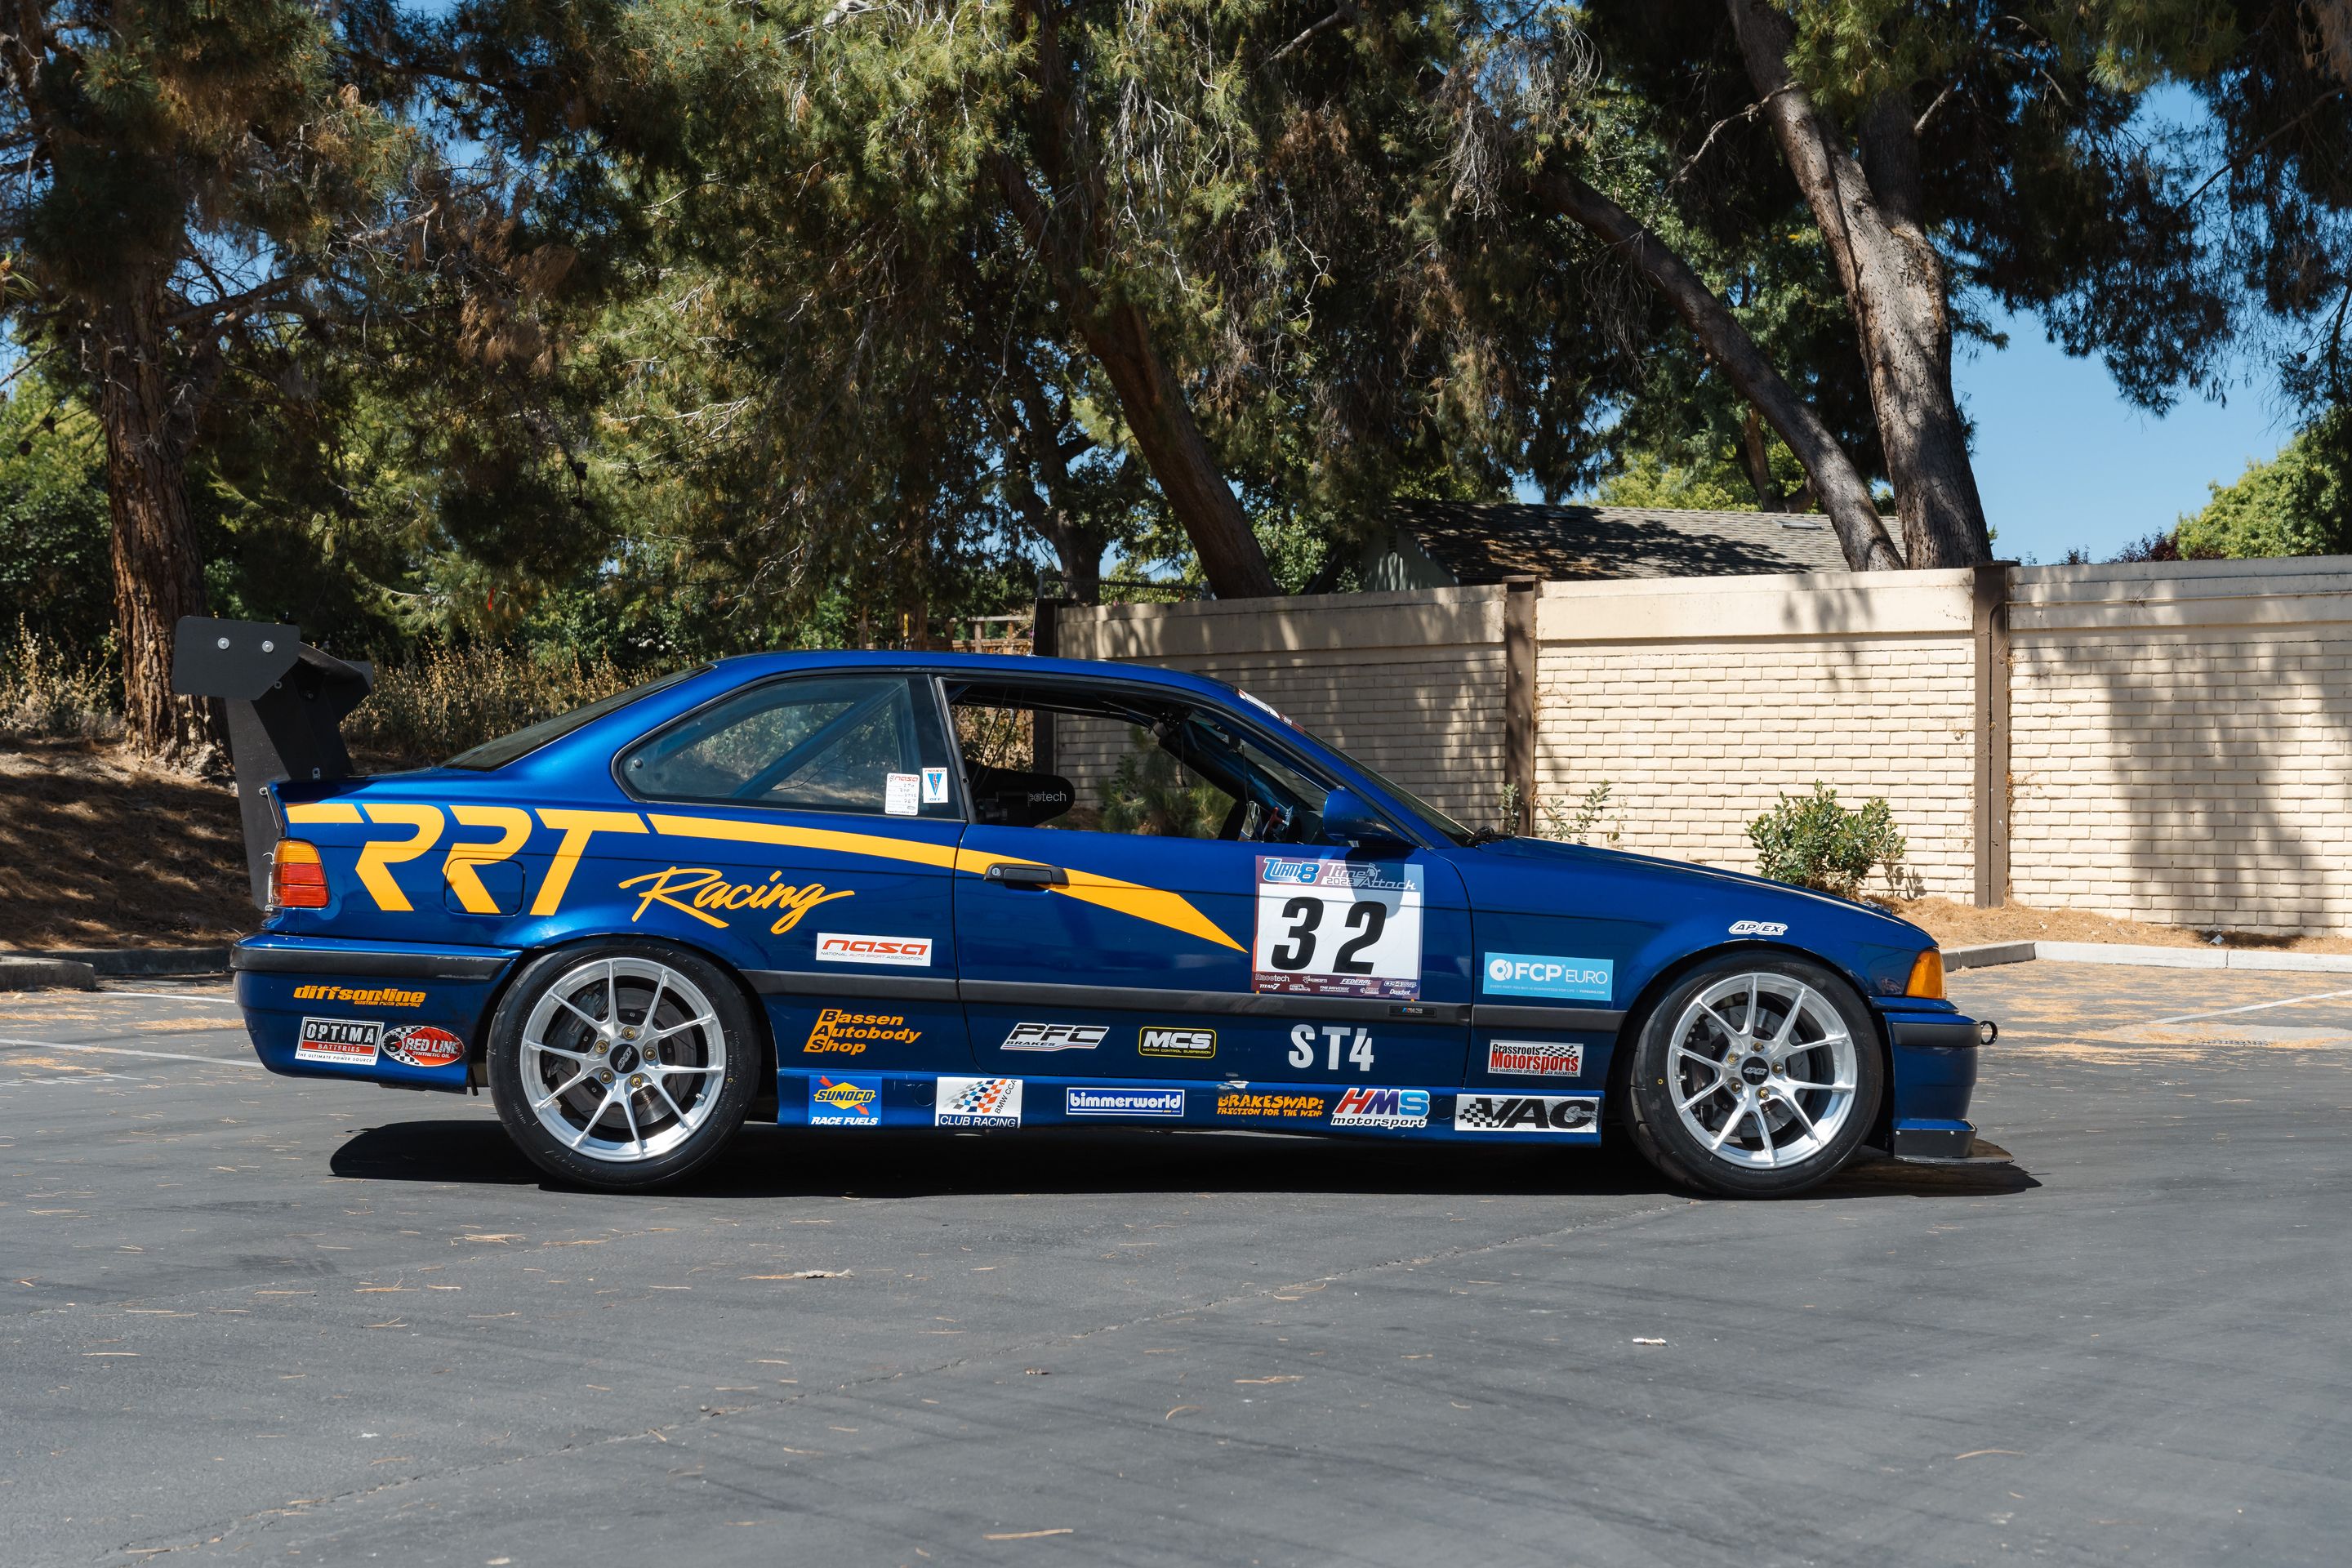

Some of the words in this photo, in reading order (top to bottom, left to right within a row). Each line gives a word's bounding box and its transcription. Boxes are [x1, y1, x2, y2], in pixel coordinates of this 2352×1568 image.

[354, 803, 650, 915] RRT
[1327, 862, 1366, 878] Time
[1326, 877, 1355, 885] 2022
[1359, 877, 1417, 891] Attack
[618, 866, 855, 935] Racing
[1735, 924, 1781, 933] APEX
[822, 939, 928, 956] nasa
[1254, 973, 1290, 982] Racetech
[1515, 962, 1562, 982] FCP
[1565, 969, 1608, 985] EURO
[293, 985, 426, 1003] diffsonline
[821, 1010, 904, 1026] Bassen
[305, 1022, 376, 1044] OPTIMA
[813, 1024, 923, 1044] Autobody
[1009, 1024, 1107, 1044] PFC
[1143, 1031, 1213, 1049] MCS
[317, 1044, 361, 1053] BATTERIES
[404, 1037, 431, 1052] RED
[433, 1039, 460, 1054] LINE
[808, 1039, 866, 1055] Shop
[1493, 1044, 1540, 1055] Grassroots
[1491, 1052, 1579, 1075] Motorsports
[817, 1089, 874, 1102] SUNOCO
[995, 1098, 1008, 1114] BMW
[1006, 1080, 1017, 1096] CCA
[1070, 1091, 1181, 1109] bimmerworld
[1334, 1089, 1429, 1116] HMS
[811, 1116, 844, 1125] RACE
[844, 1117, 879, 1125] FUELS
[1217, 1107, 1261, 1116] FRICTION
[1263, 1108, 1280, 1116] FOR
[1283, 1109, 1298, 1117] THE
[1475, 1098, 1596, 1129] VAC
[940, 1116, 970, 1125] CLUB
[972, 1117, 1016, 1128] RACING
[1332, 1116, 1426, 1129] motorsport
